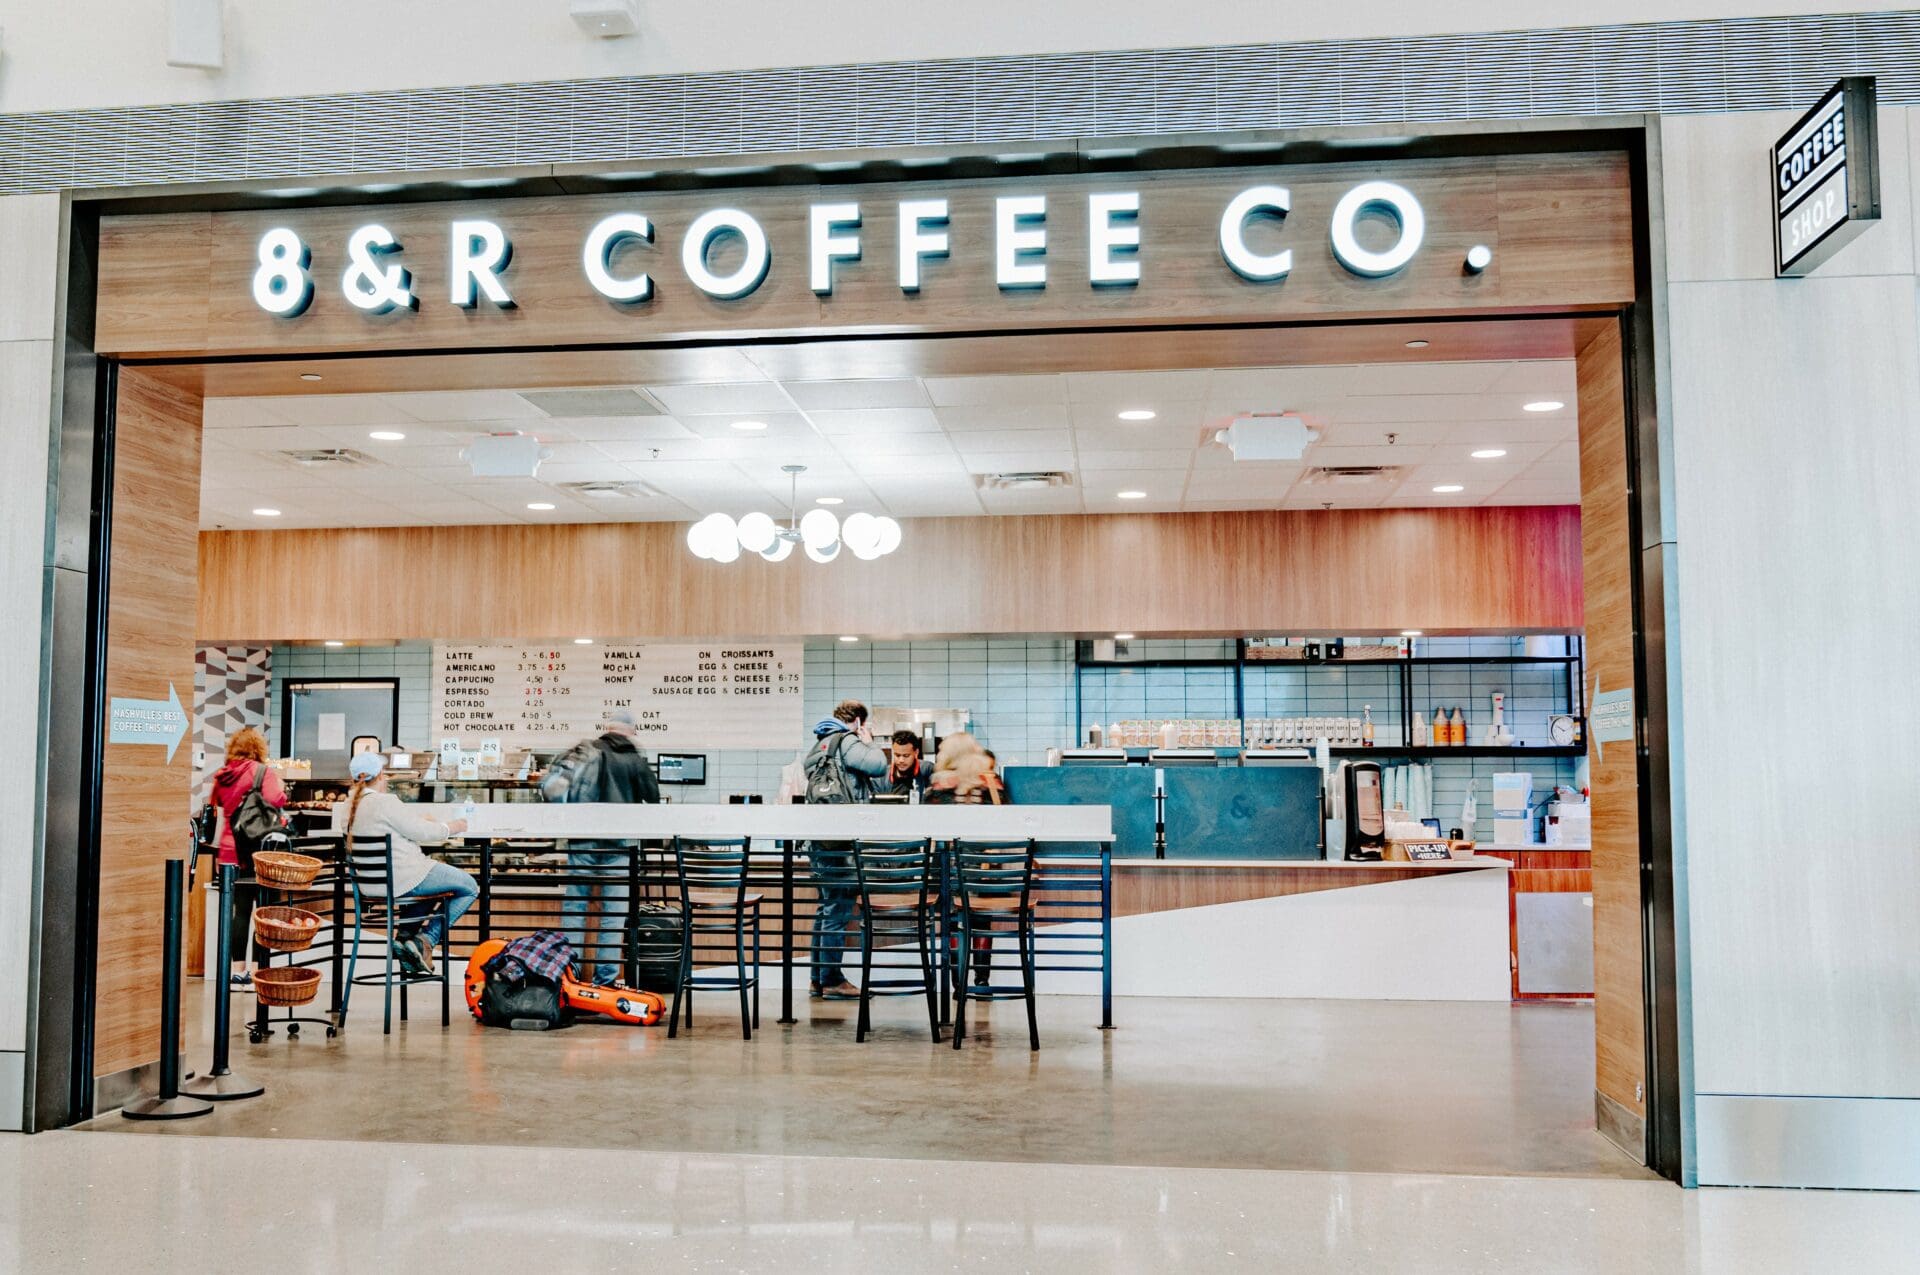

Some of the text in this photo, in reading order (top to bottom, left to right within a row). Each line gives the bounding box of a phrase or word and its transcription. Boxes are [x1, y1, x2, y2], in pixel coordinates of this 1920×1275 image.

[1779, 111, 1845, 192] COFFEE
[1791, 189, 1835, 247] SHOP
[582, 192, 1141, 302] COFFEE
[1218, 181, 1491, 281] CO.
[604, 650, 640, 660] VANILLA
[722, 650, 774, 658] CROISSANTS
[446, 664, 496, 672] AMERICANO
[602, 664, 636, 672] MOCHA
[698, 662, 716, 670] EGG
[734, 662, 768, 670] CHEESE
[778, 662, 782, 670] 6
[446, 676, 494, 684] CAPPUCINO
[604, 676, 634, 684] HONEY
[698, 674, 716, 682] EGG
[734, 674, 770, 682] CHEESE
[446, 688, 490, 696] ESPRESSO
[698, 686, 716, 694] EGG
[734, 686, 770, 694] CHEESE
[444, 700, 484, 708] CORTADO
[114, 708, 181, 720] NASHVILLE'S BEST
[444, 712, 466, 720] COLD
[470, 712, 494, 720] BREW
[114, 722, 177, 733] COFFEE THIS WAY
[464, 724, 514, 732] CHOCOLATE
[634, 724, 668, 732] ALMOND
[1408, 844, 1447, 852] PICK-UP
